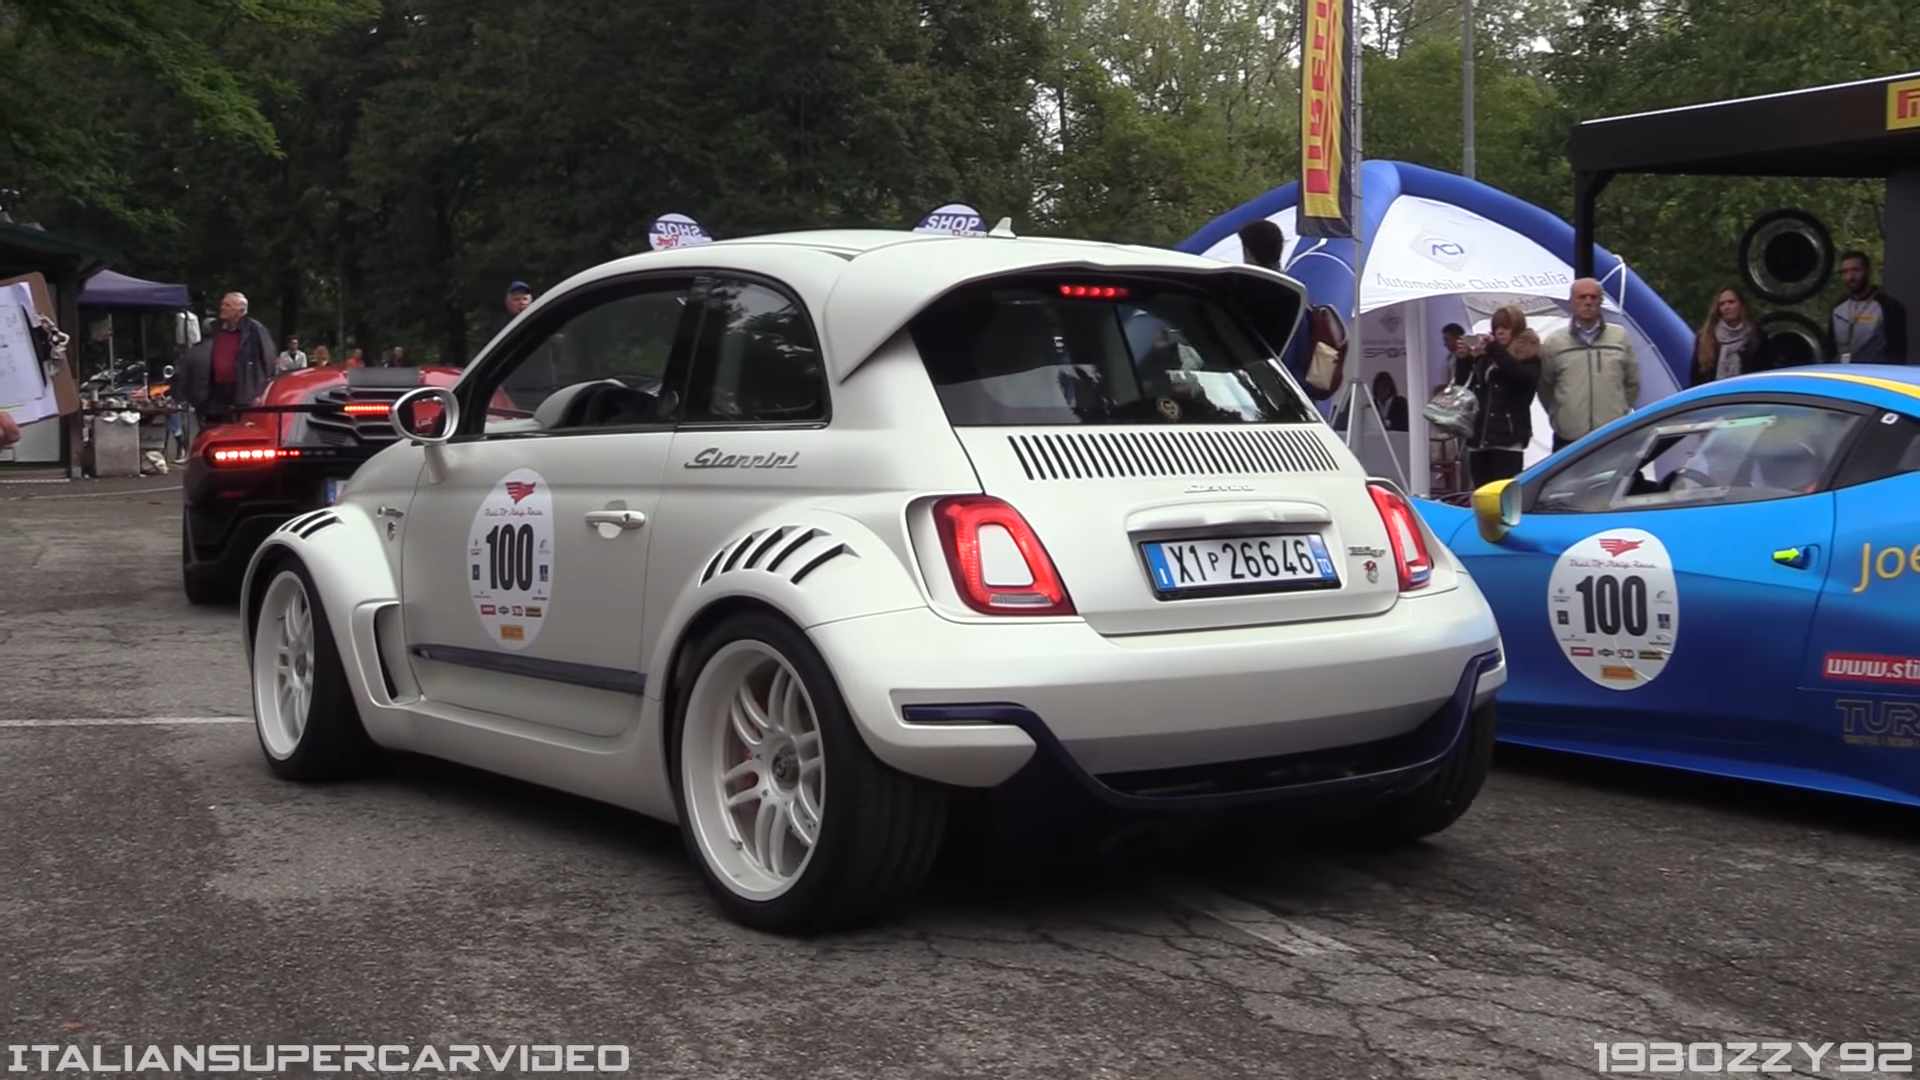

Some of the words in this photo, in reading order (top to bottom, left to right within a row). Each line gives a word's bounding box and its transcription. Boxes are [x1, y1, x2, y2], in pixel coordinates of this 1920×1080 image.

[925, 215, 980, 231] SHOP
[1376, 272, 1467, 290] Automobile
[1469, 278, 1509, 290] Club
[1511, 271, 1569, 288] d'Italia
[684, 447, 800, 469] Giannini
[485, 523, 534, 591] 100
[1575, 574, 1648, 637] 100
